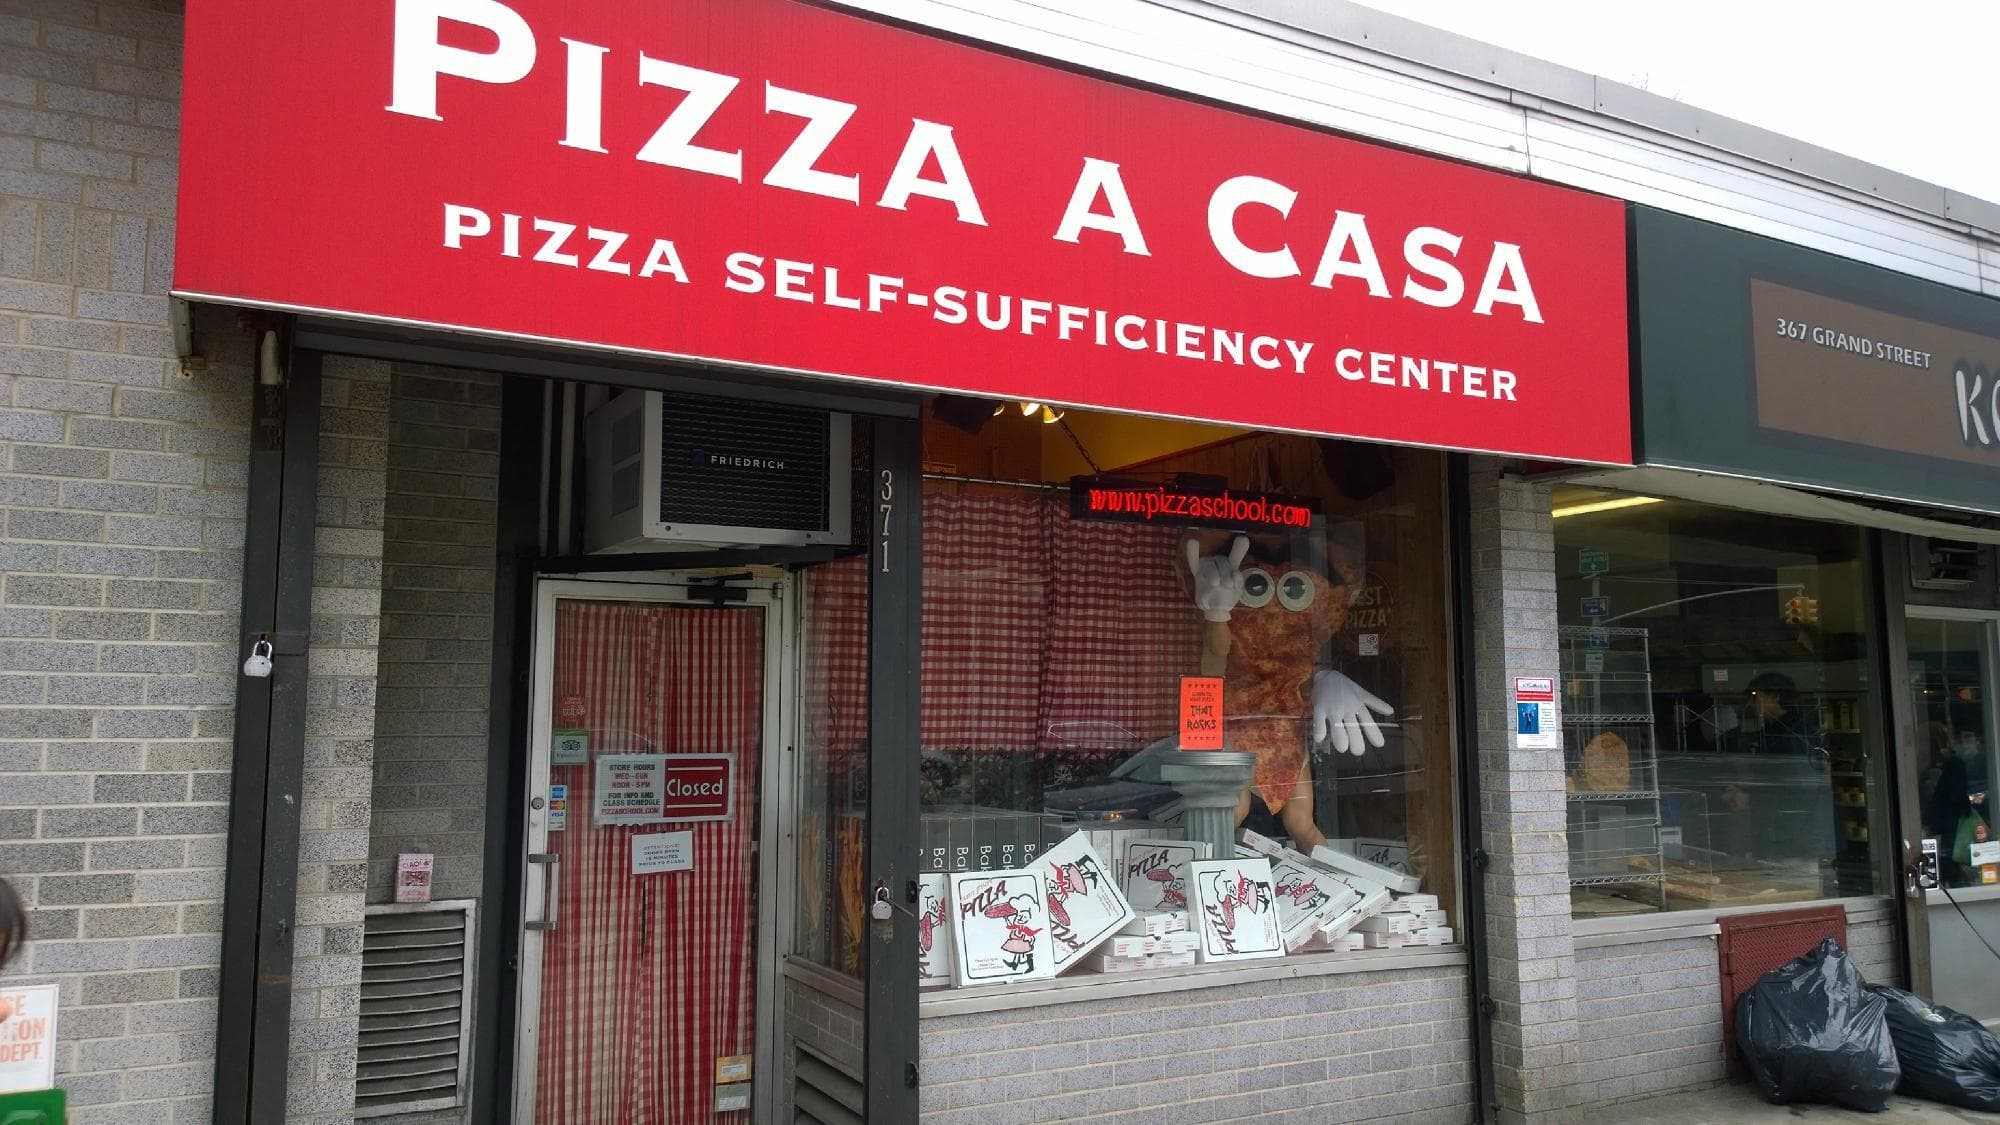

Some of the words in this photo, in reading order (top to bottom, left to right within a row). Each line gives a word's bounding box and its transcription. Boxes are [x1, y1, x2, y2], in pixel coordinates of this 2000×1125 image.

[384, 0, 988, 228] PIZZA
[1053, 156, 1152, 257] A
[1207, 175, 1545, 324] CASA
[442, 203, 690, 284] PIZZA
[724, 252, 1314, 374] SELF-SUFFICIENCY
[1336, 348, 1518, 401] CENTER
[1776, 317, 1808, 341] 367
[1813, 327, 1873, 356] GRAND
[1877, 342, 1931, 369] STREET
[710, 455, 785, 470] FRIEDRICH
[880, 470, 893, 573] 371
[1089, 487, 1311, 528] www.pizzaschool.com
[1187, 719, 1217, 730] ROCKS
[1190, 705, 1213, 717] THAT
[627, 798, 660, 806] SCHEDULE
[666, 778, 723, 796] Closed
[1128, 849, 1169, 878] PIZZA
[960, 880, 1008, 920] PIZZA
